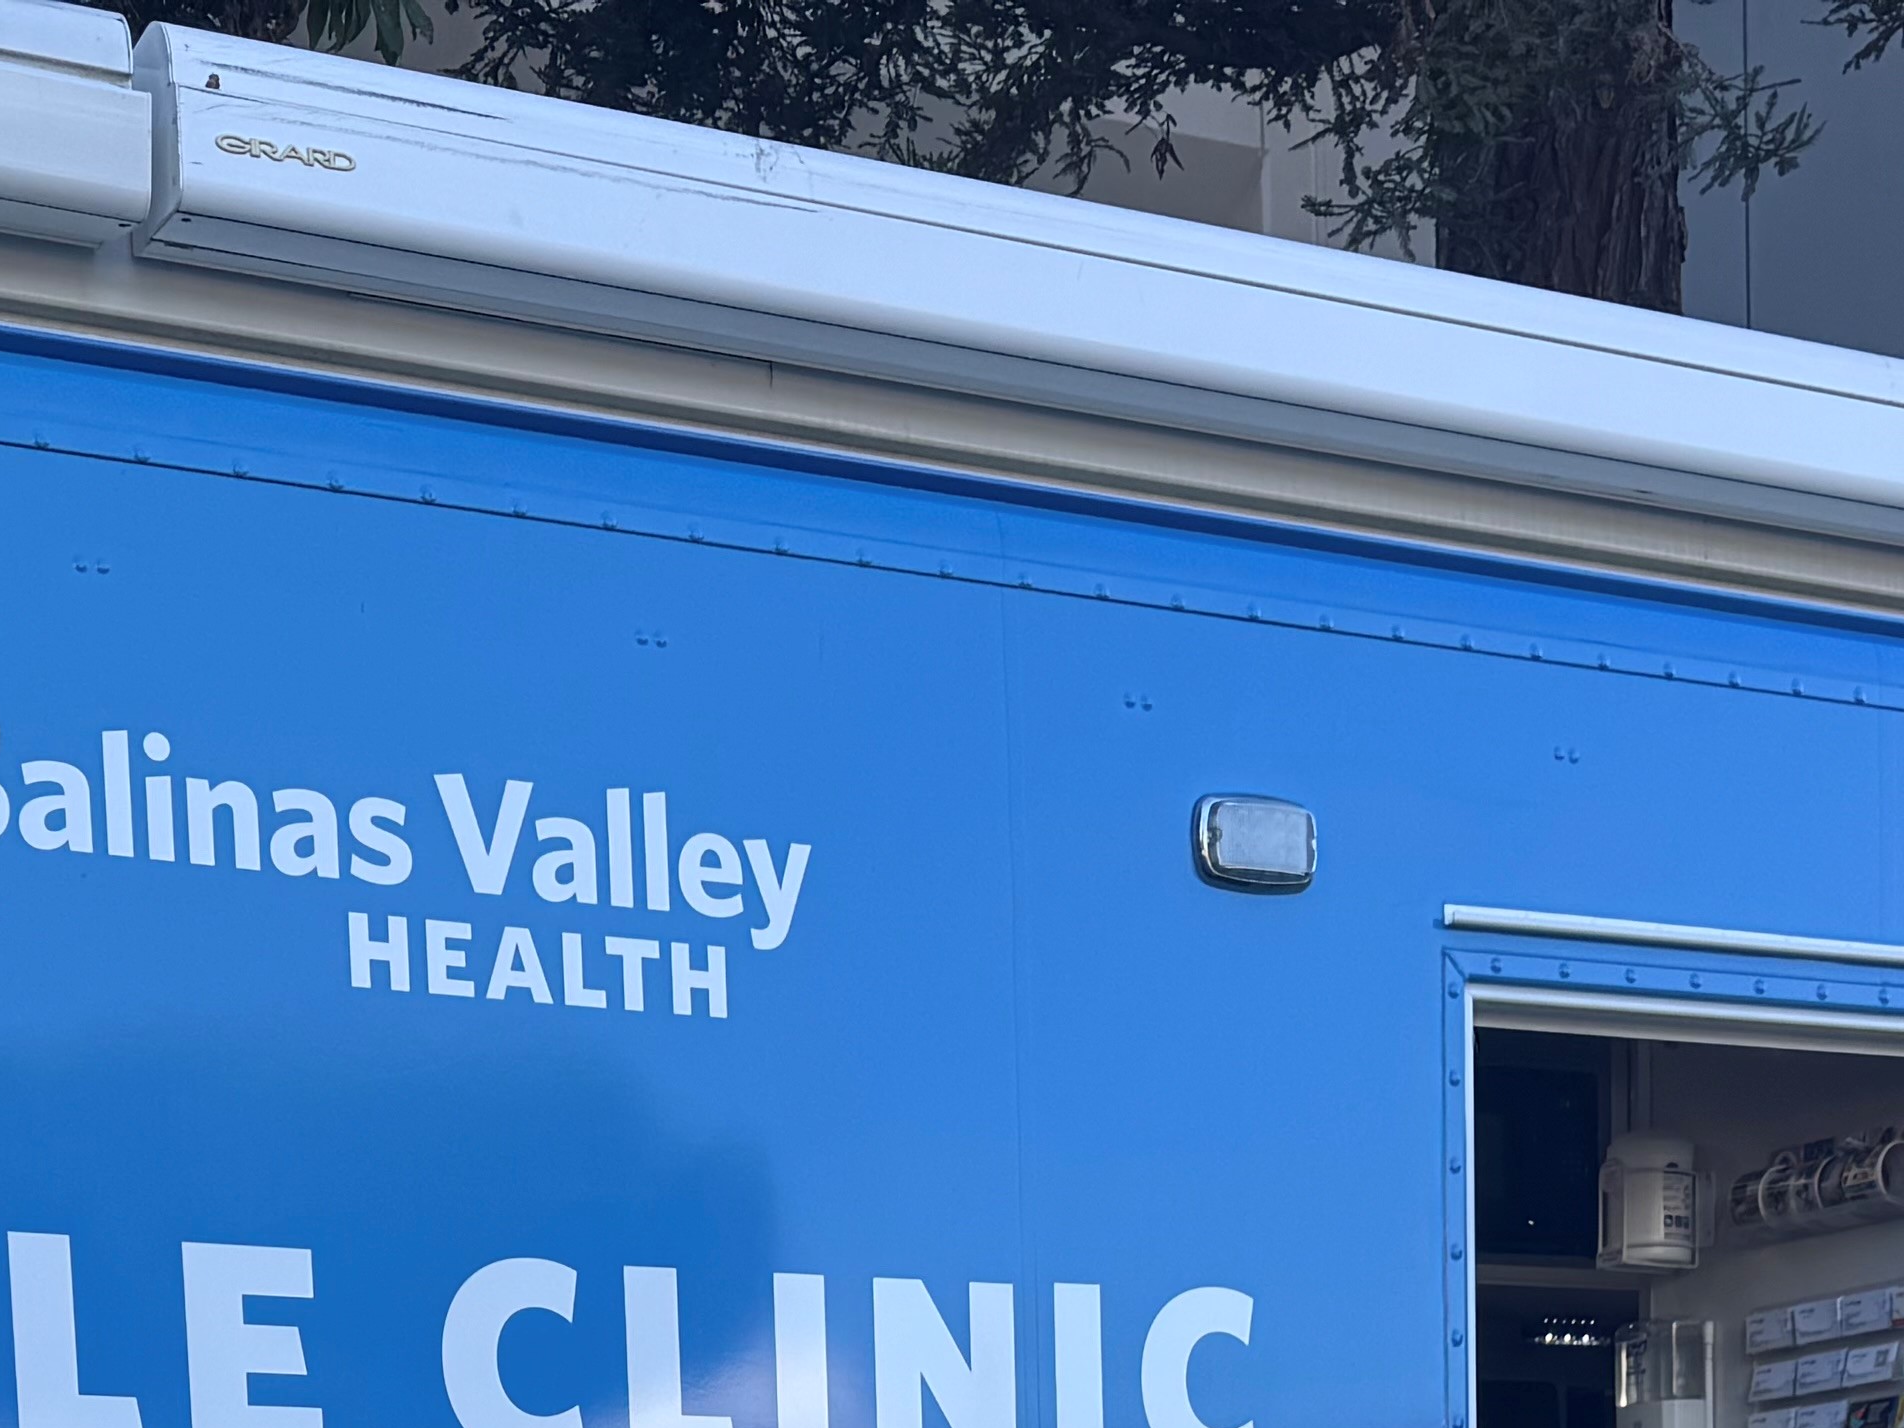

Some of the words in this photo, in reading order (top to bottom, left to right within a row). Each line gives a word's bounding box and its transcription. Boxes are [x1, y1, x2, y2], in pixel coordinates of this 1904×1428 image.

[215, 134, 356, 172] GIRARD
[435, 773, 812, 949] Valley
[348, 911, 728, 1018] HEALTH
